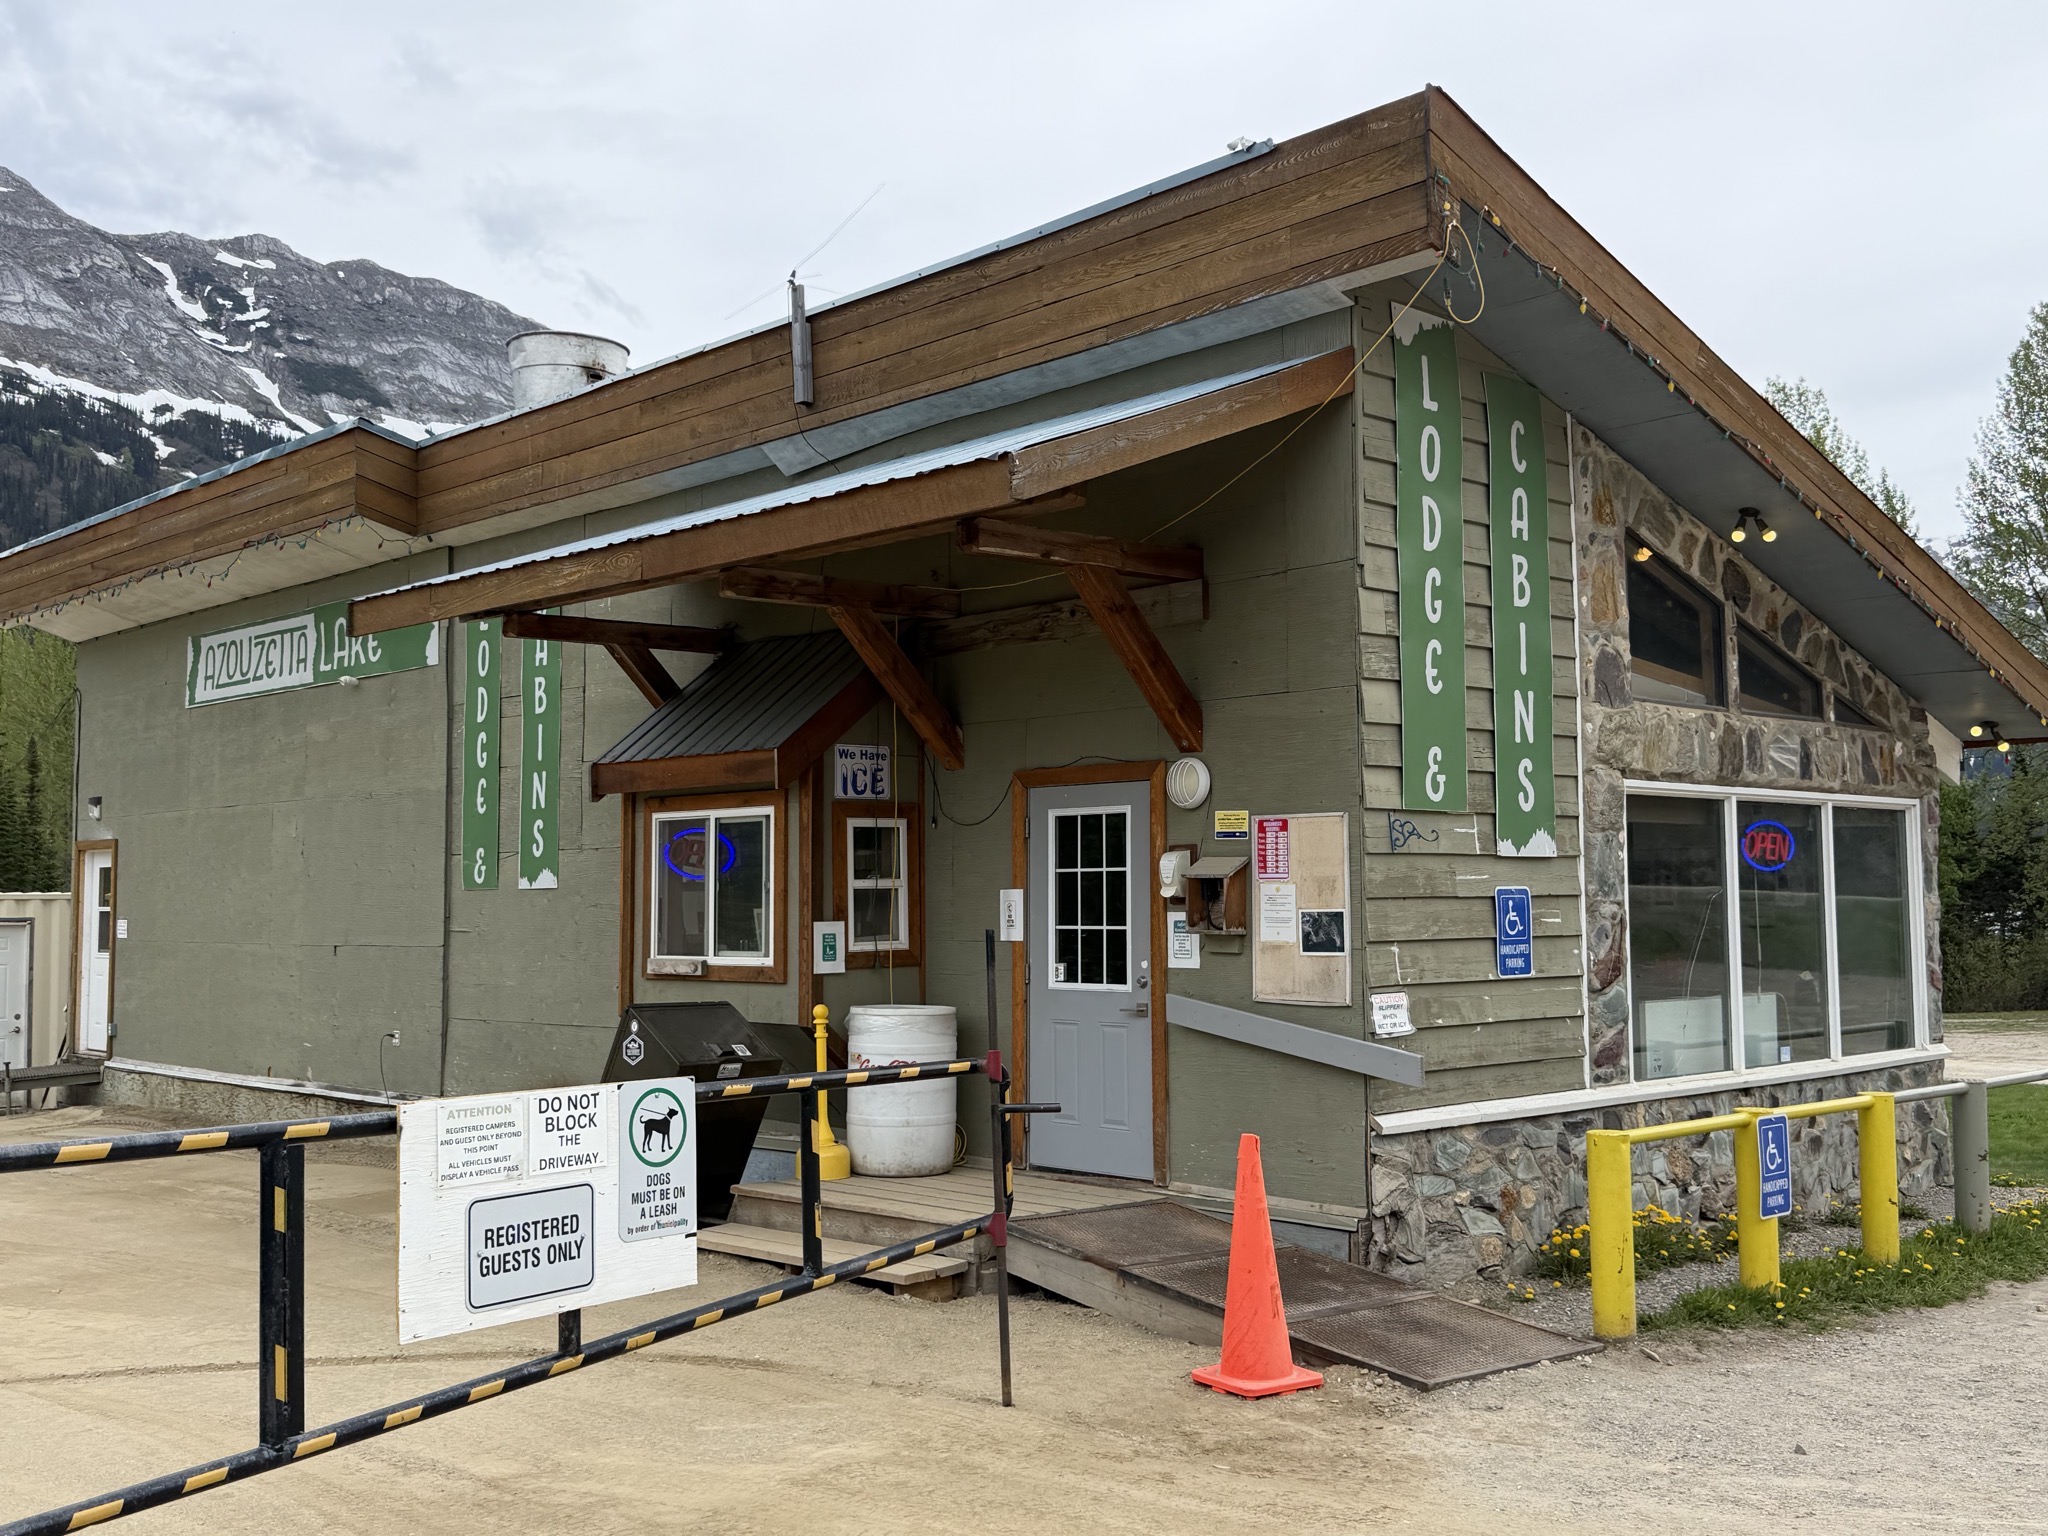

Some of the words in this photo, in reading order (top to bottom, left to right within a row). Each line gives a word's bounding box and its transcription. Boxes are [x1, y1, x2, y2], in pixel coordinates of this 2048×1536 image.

[1420, 355, 1443, 694] LODGE
[1511, 420, 1535, 812] CABINS
[204, 624, 309, 691] AZOUZETTA
[476, 621, 490, 815] ODGE
[532, 611, 547, 858] ABINS
[838, 748, 856, 760] We
[860, 750, 887, 761] Have
[841, 762, 885, 796] ICE
[1426, 746, 1446, 802] &
[1744, 831, 1790, 862] OPEN
[474, 847, 486, 884] &
[1500, 943, 1530, 955] HANDICAPPED
[1505, 957, 1525, 969] PARKING
[1374, 995, 1405, 1005] CAUTION
[1378, 1003, 1404, 1012] SLIPPERY
[538, 1096, 563, 1114] DO
[567, 1091, 600, 1112] NOT
[447, 1104, 512, 1121] ATTENTION
[446, 1124, 485, 1135] REGISTERED
[485, 1120, 516, 1131] CAMPERS
[545, 1112, 598, 1133] BLOCK
[439, 1139, 454, 1147] AND
[455, 1136, 476, 1145] GUEST
[476, 1133, 495, 1142] ONLY
[495, 1130, 523, 1140] BEYOND
[558, 1133, 581, 1147] THE
[463, 1147, 479, 1155] THIS
[479, 1143, 499, 1153] POINT
[448, 1162, 461, 1170] ALL
[461, 1157, 493, 1168] VEHICLES
[493, 1154, 512, 1163] MUST
[539, 1152, 600, 1171] DRIVEWAY
[440, 1171, 468, 1182] DISPLAY
[468, 1170, 474, 1178] A
[474, 1166, 502, 1177] VEHICLE
[503, 1164, 520, 1173] PASS
[646, 1172, 671, 1187] DOGS
[631, 1189, 657, 1206] MUST
[659, 1187, 671, 1201] BE
[673, 1185, 686, 1199] ON
[1767, 1193, 1785, 1208] PARKING
[640, 1207, 646, 1220] A
[648, 1202, 677, 1219] LEASH
[484, 1213, 580, 1250] REGISTERED
[627, 1226, 634, 1236] by
[635, 1224, 650, 1233] order
[650, 1222, 657, 1231] of
[479, 1246, 541, 1278] GUESTS
[547, 1236, 585, 1265] ONLY
